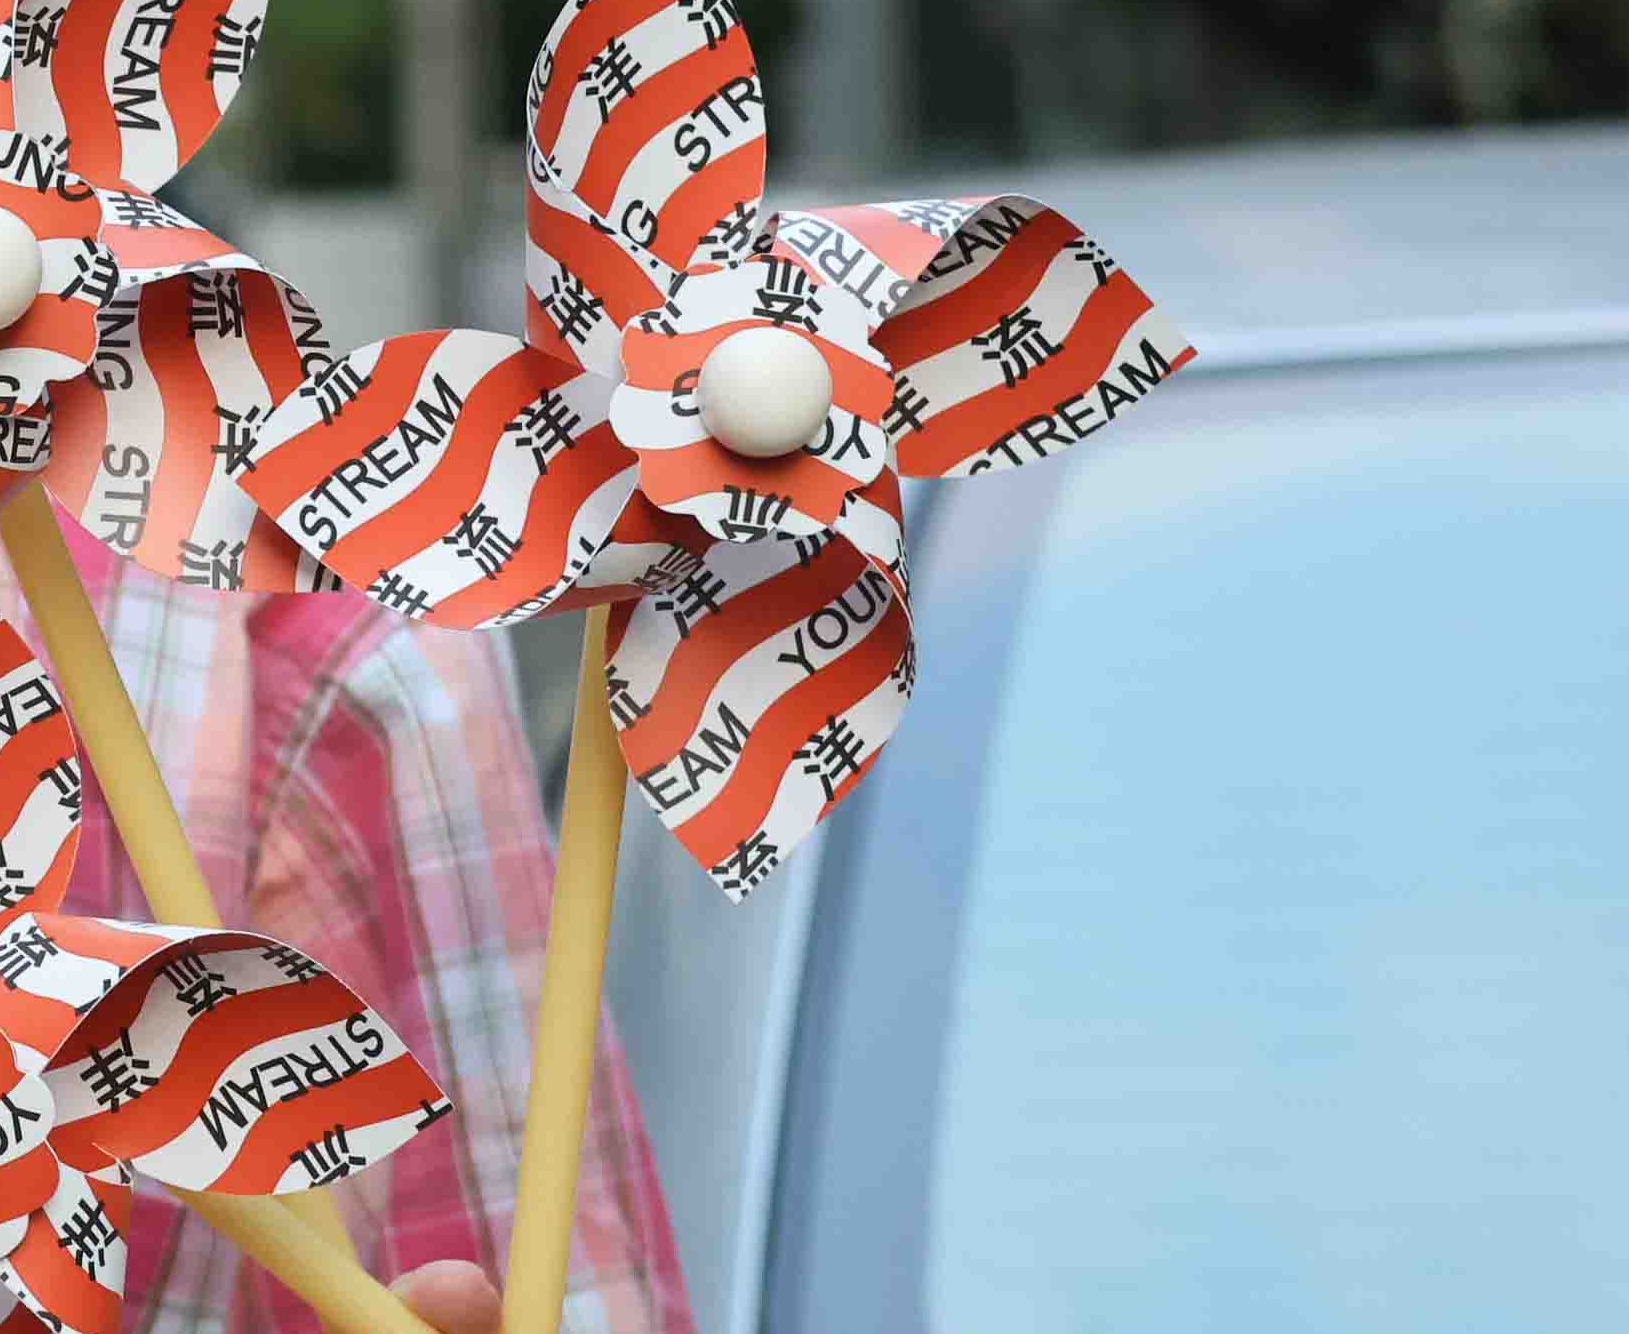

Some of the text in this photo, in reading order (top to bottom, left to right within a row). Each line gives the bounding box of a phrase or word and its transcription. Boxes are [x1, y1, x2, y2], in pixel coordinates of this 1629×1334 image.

[674, 75, 762, 173] STR
[299, 368, 464, 552] STREAM
[636, 567, 896, 810] EAM YOUN
[199, 1012, 384, 1152] STREAM
